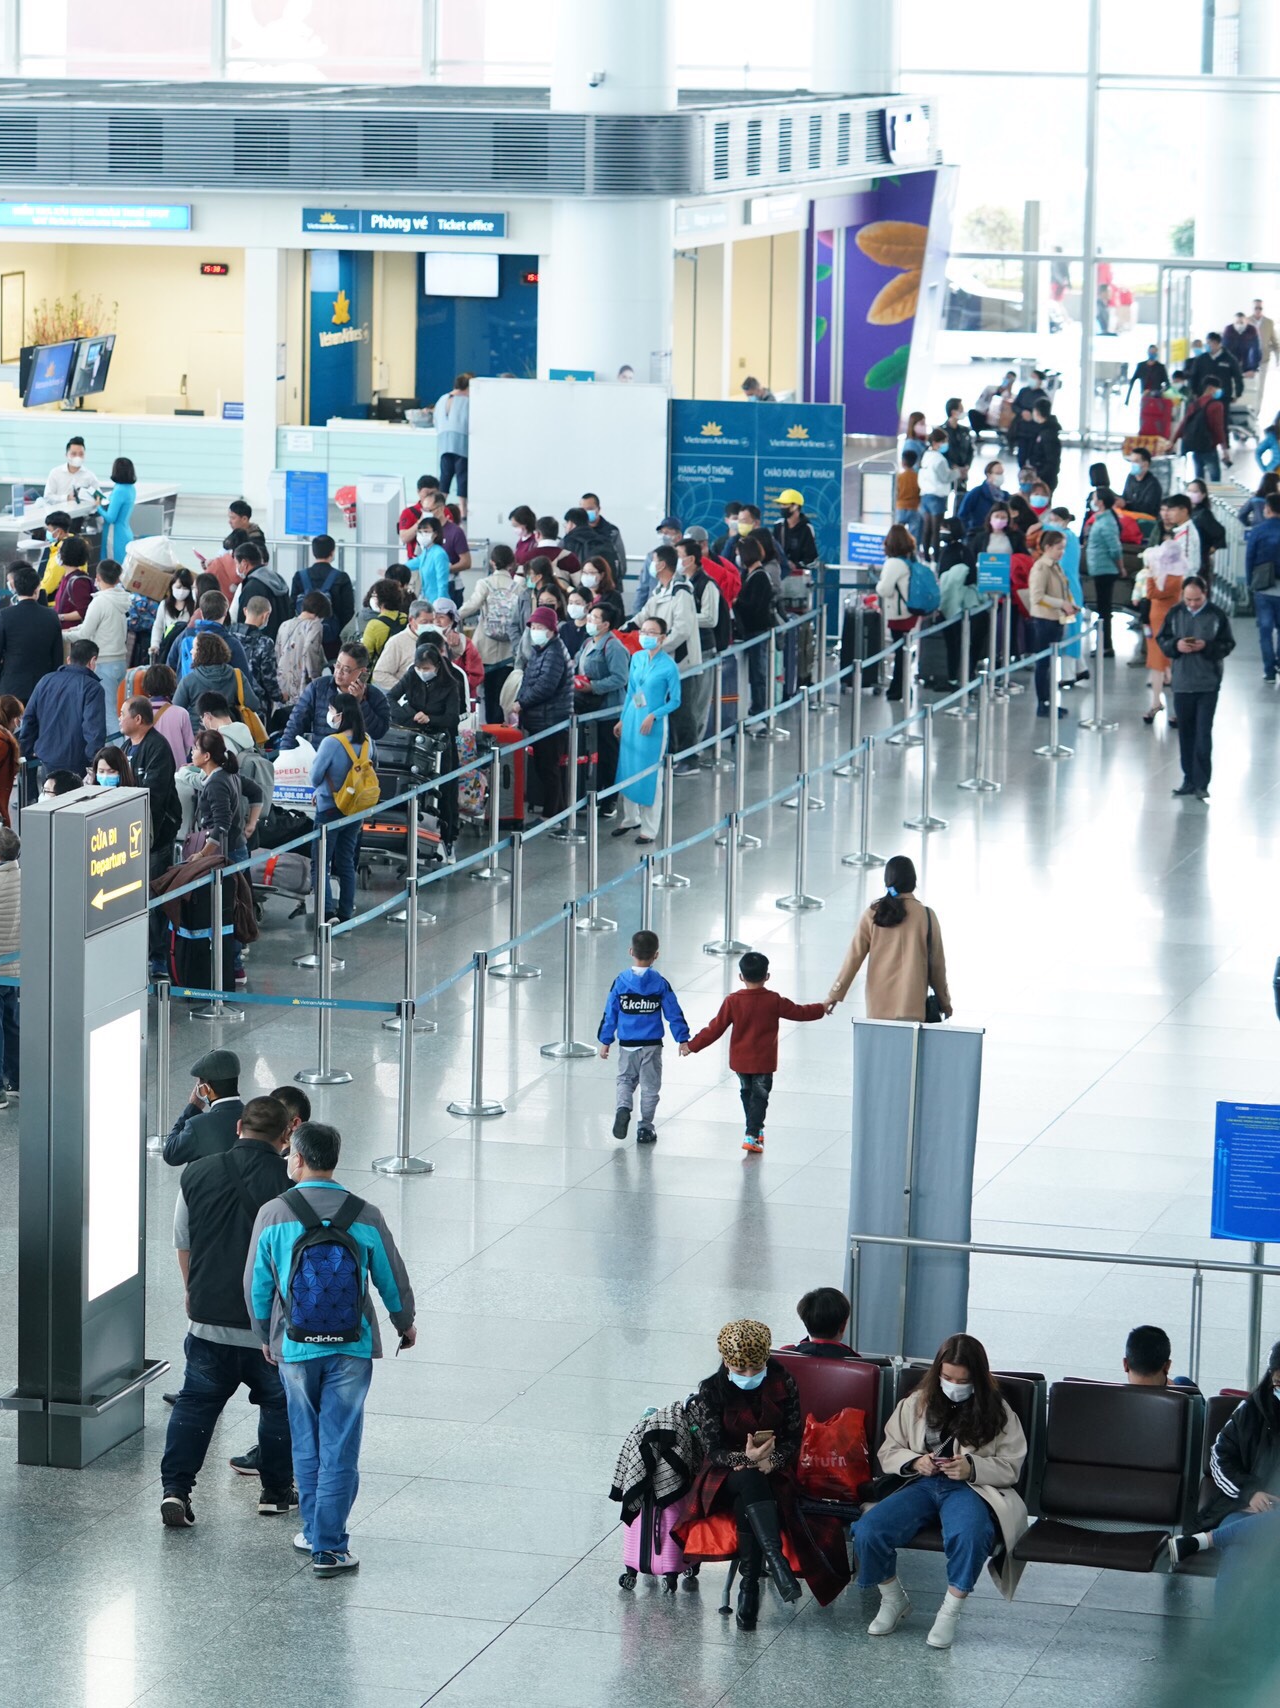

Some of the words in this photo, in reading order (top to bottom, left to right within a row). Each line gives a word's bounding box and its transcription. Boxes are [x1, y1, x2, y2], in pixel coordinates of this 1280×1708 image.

[371, 214, 411, 232] Phòng
[413, 215, 429, 230] vé
[438, 218, 465, 231] Ticket
[467, 220, 495, 232] office
[90, 851, 127, 877] Departure
[304, 1335, 344, 1343] adidas
